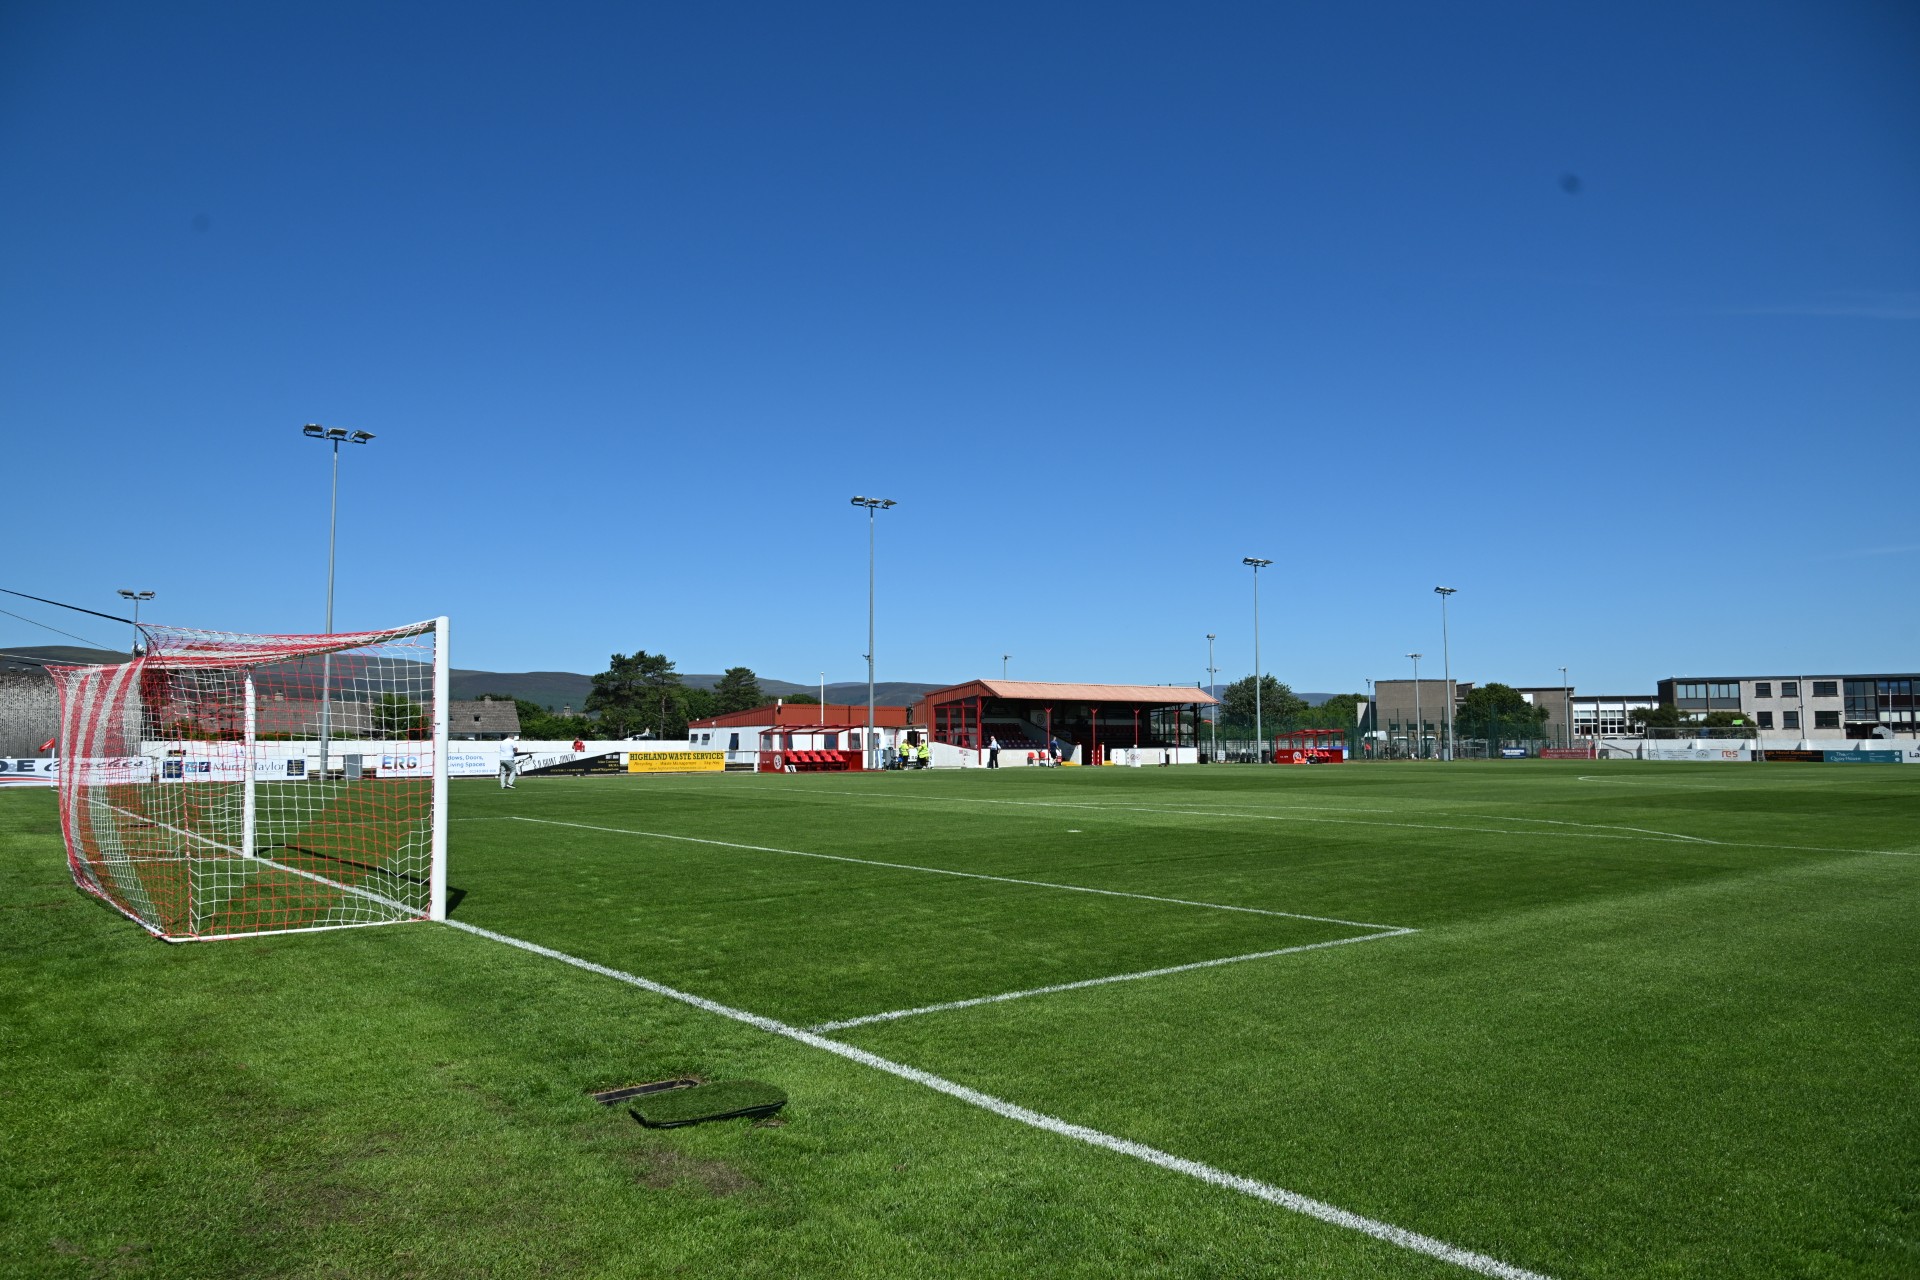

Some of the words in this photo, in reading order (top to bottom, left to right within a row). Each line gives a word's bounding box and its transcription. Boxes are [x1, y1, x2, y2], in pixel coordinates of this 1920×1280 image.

[382, 756, 417, 770] ERG
[630, 753, 668, 761] HIGHLAND
[693, 752, 724, 760] SERVICES
[44, 757, 143, 772] Caches
[213, 760, 246, 772] Murra
